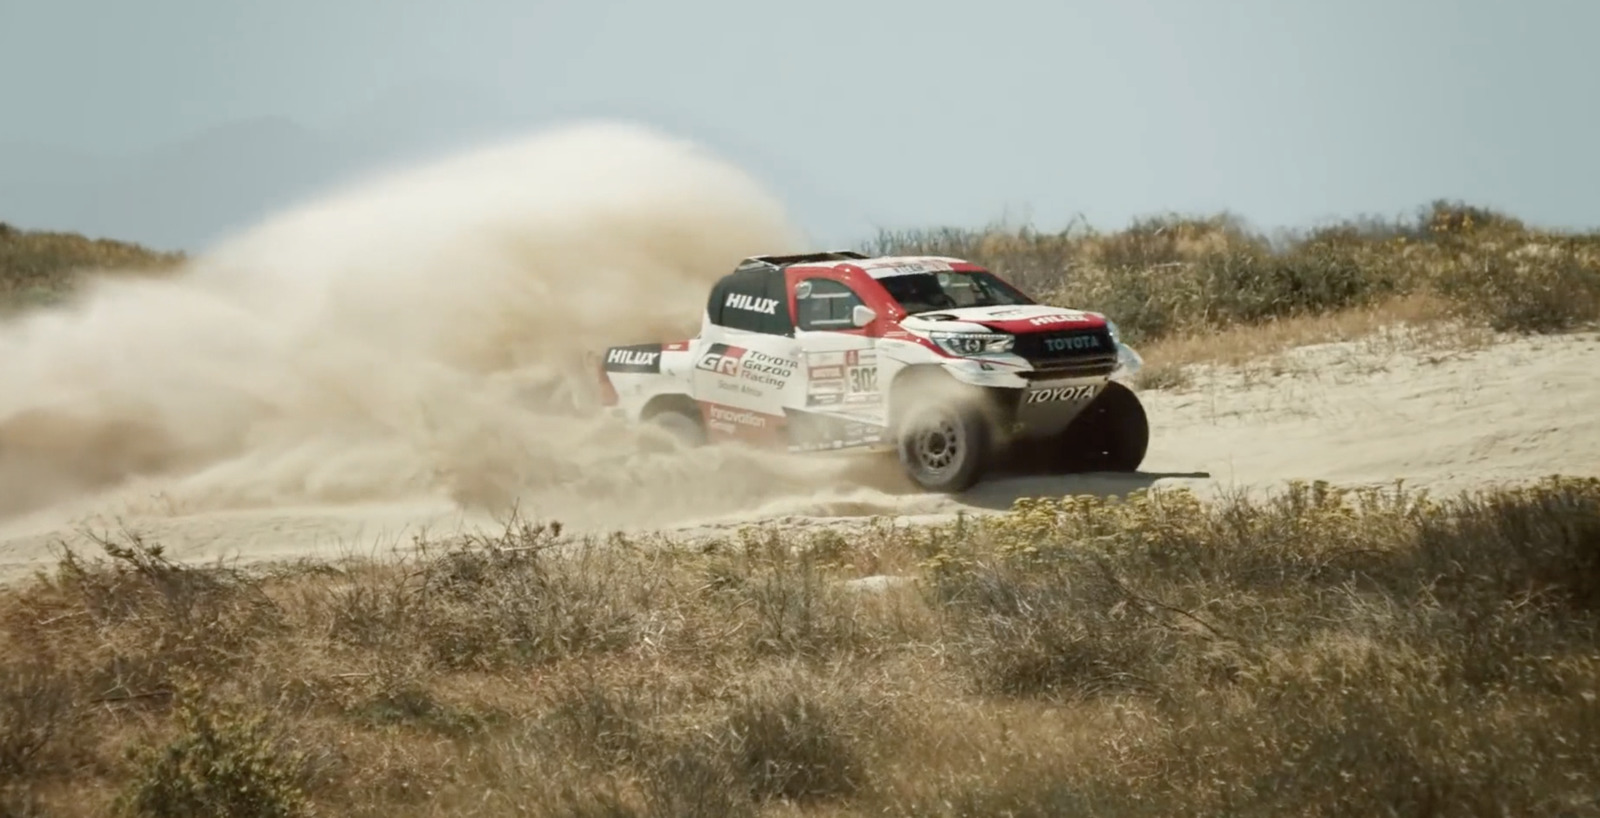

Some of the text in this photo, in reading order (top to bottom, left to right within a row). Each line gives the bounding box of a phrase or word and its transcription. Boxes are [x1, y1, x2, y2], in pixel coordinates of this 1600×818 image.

[726, 293, 779, 315] HILUX
[1045, 335, 1099, 351] TOYOTA
[607, 349, 659, 366] HILUX
[699, 353, 738, 376] GR
[749, 351, 799, 369] TOYOTA
[743, 360, 791, 378] GAZOO
[740, 371, 785, 389] Racing
[1027, 385, 1096, 404] TOYOTA
[710, 405, 765, 428] Innovation
